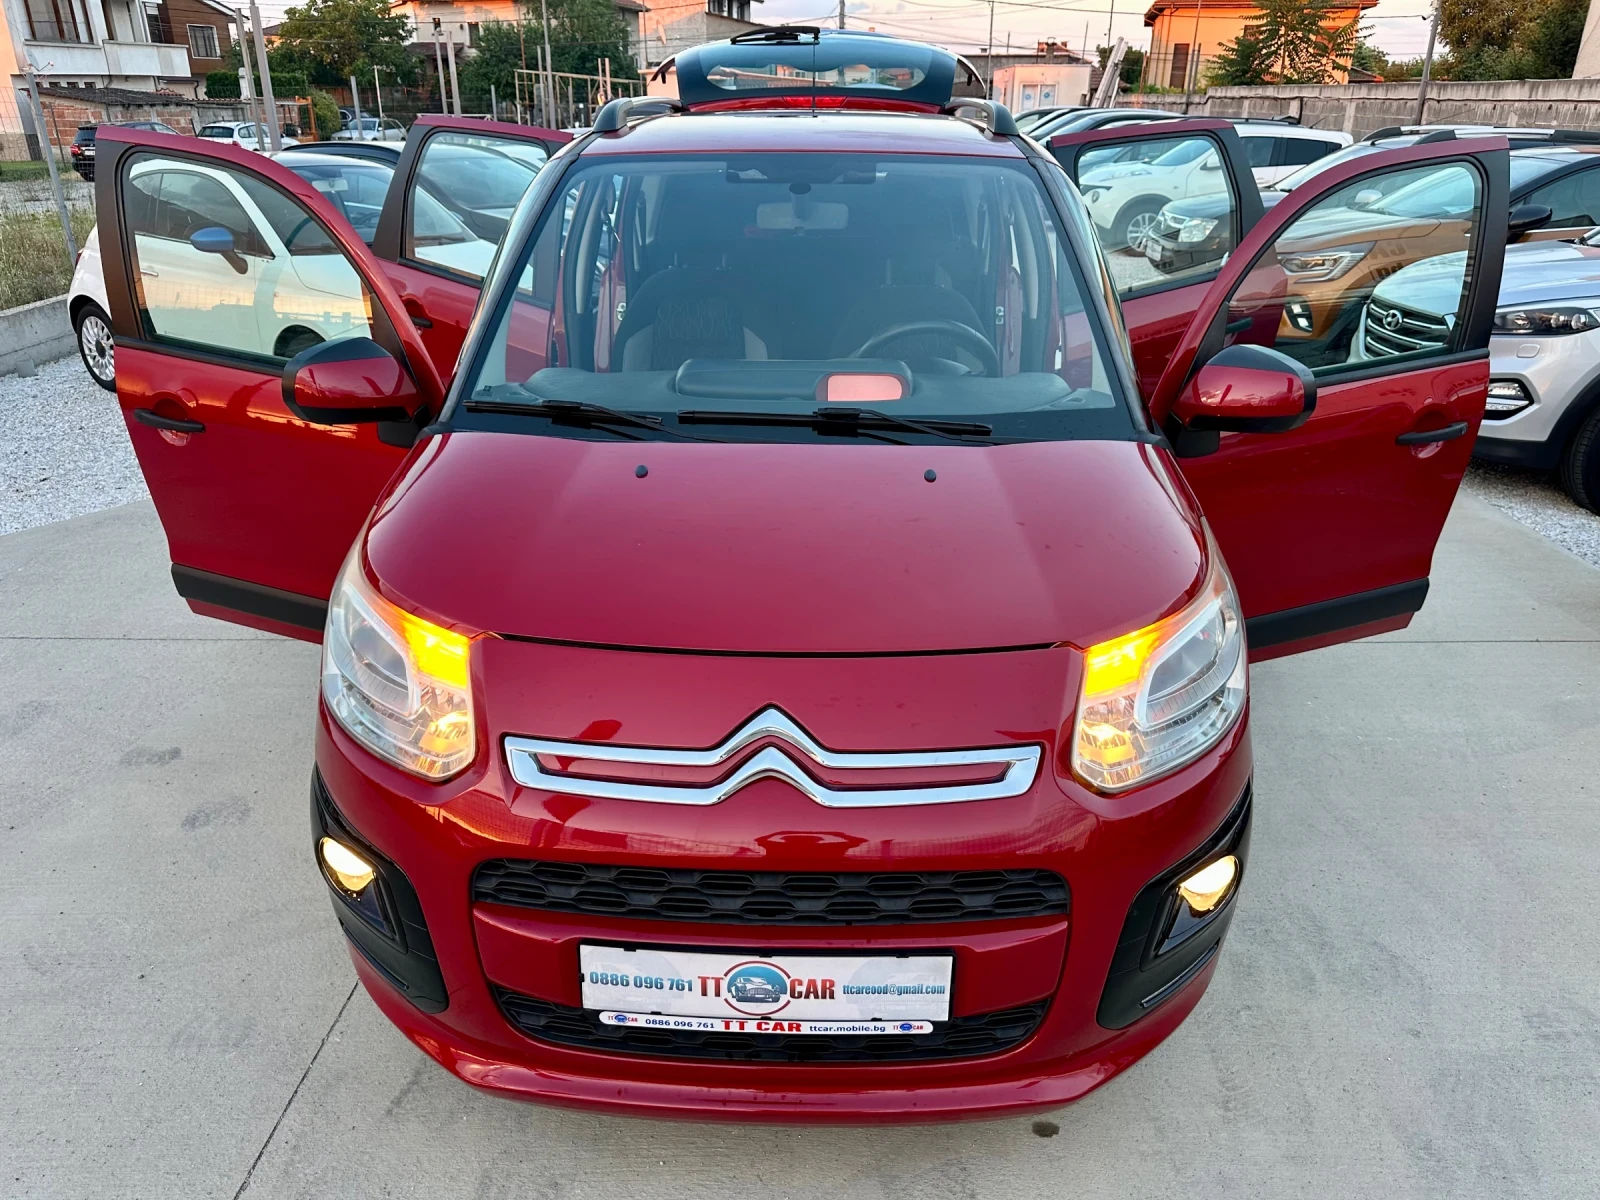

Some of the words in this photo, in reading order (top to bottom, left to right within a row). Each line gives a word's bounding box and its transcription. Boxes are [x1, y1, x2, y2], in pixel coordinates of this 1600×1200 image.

[589, 971, 630, 987] 0886
[633, 975, 664, 990] 096
[667, 977, 693, 992] 761
[697, 976, 724, 998] TT
[789, 978, 835, 1000] CAR
[842, 983, 946, 996] ttcareood@gmail.com
[645, 1018, 671, 1026] 0886
[673, 1020, 693, 1028] 096
[696, 1021, 715, 1029] 761
[721, 1020, 749, 1031] TT
[756, 1021, 802, 1032] CAR
[809, 1024, 886, 1033] ttcar.mobile.bg
